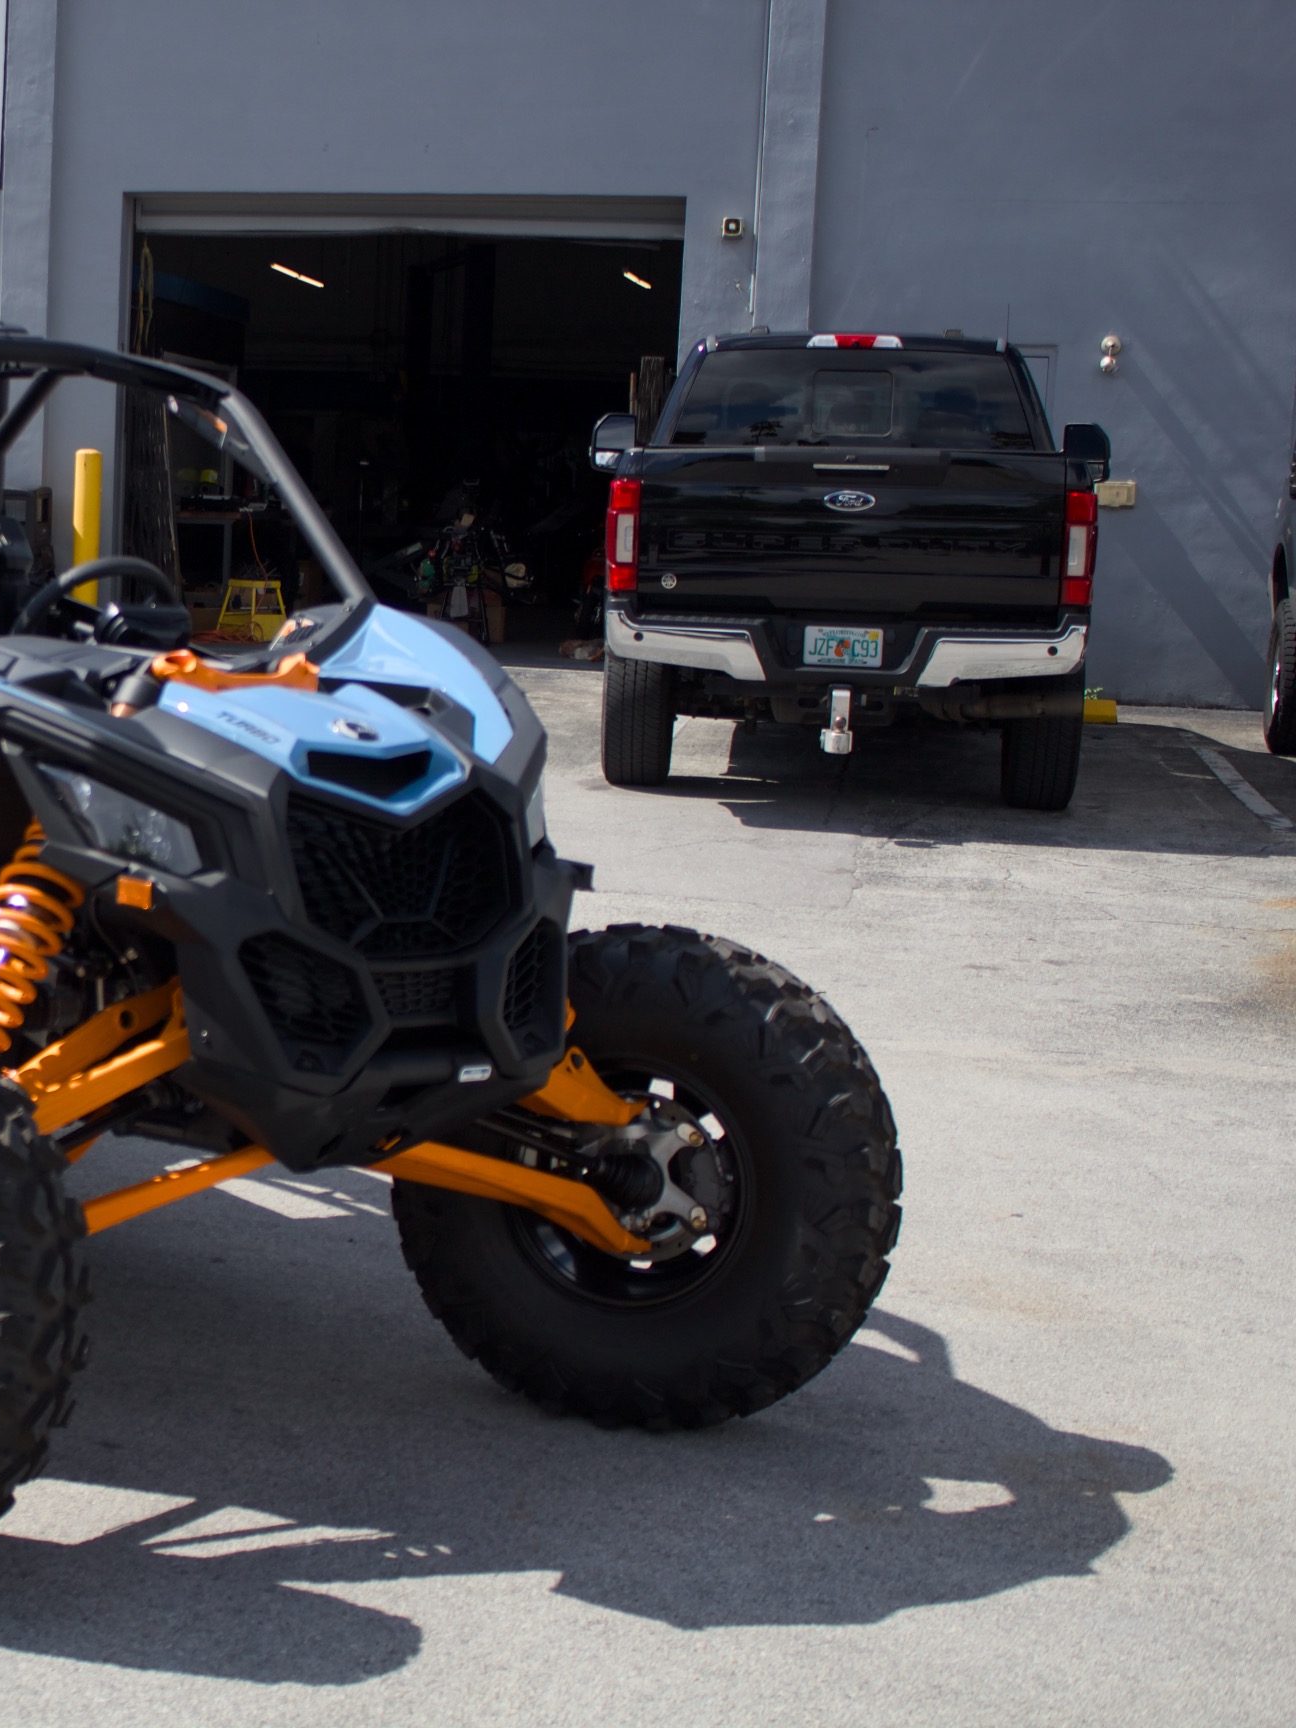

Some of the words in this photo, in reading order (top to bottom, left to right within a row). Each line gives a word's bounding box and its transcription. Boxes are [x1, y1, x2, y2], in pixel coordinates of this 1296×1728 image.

[835, 494, 864, 507] Ford
[809, 638, 835, 656] JZF
[851, 639, 879, 658] C93
